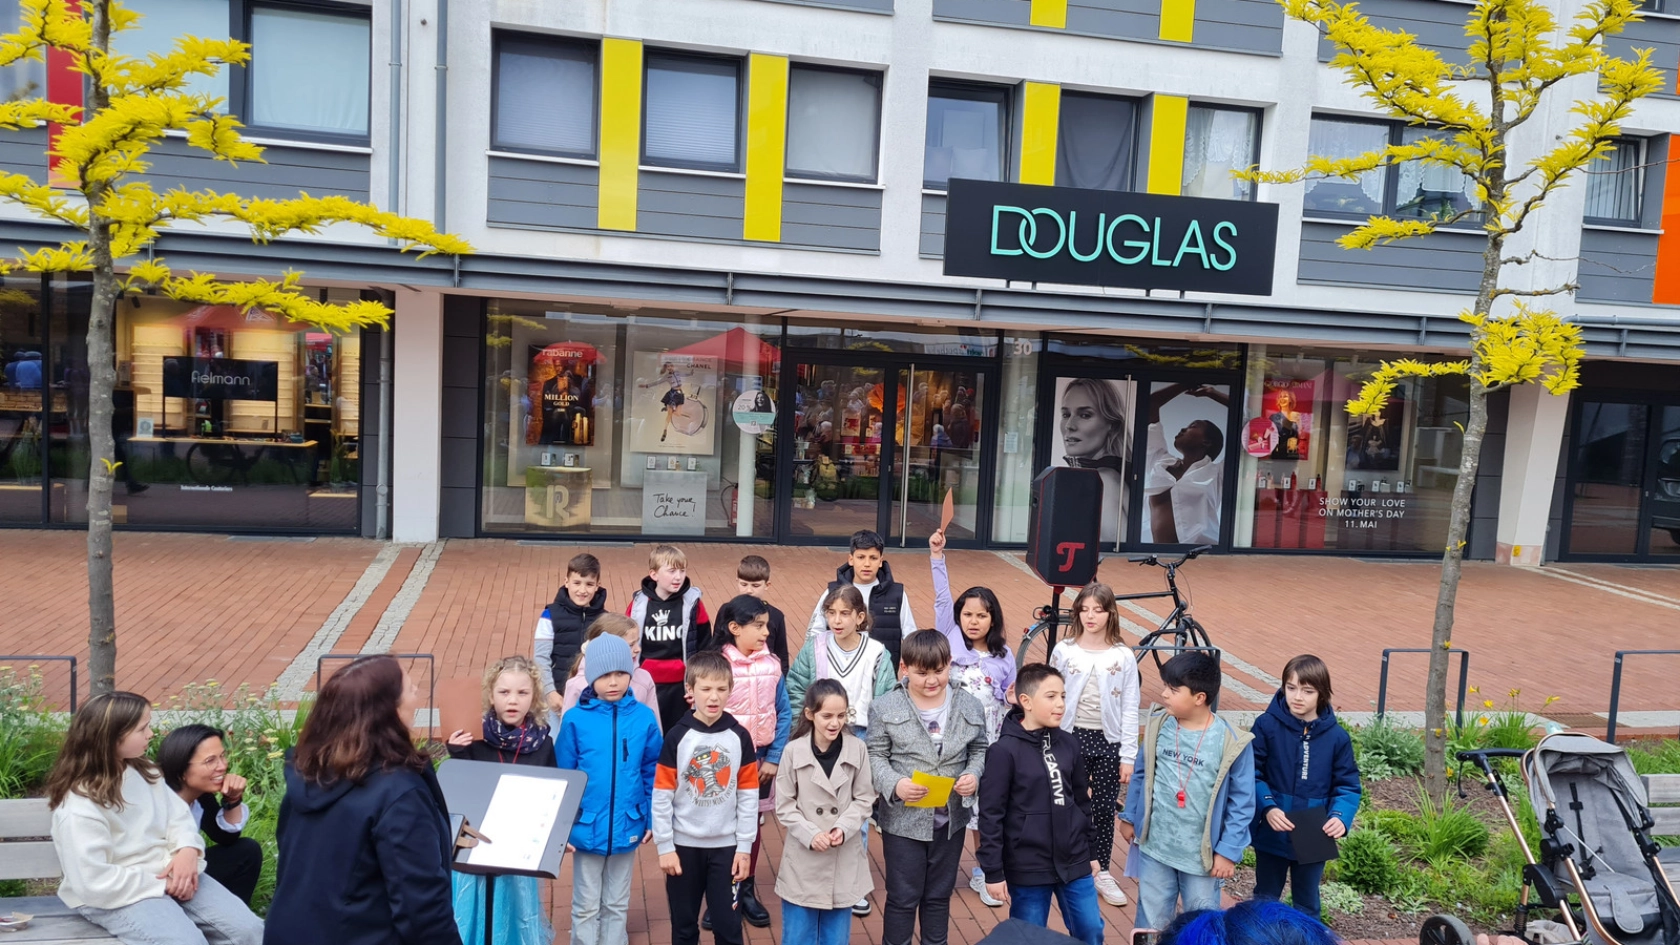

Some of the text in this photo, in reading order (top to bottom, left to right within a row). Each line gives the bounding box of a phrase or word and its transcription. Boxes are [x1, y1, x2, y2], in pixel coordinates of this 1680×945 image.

[990, 204, 1238, 271] DOUGLAS
[1013, 339, 1032, 355] 30
[542, 348, 583, 358] rabanne
[686, 362, 711, 370] CHANEL
[544, 393, 579, 401] MILLION
[652, 493, 673, 504] Take
[1319, 497, 1406, 507] SHOW YOUR LOVE
[1318, 508, 1405, 518] ON MOTHER'S DAY
[1345, 520, 1378, 529] 11. MAI
[1162, 748, 1205, 767] NEW YORK
